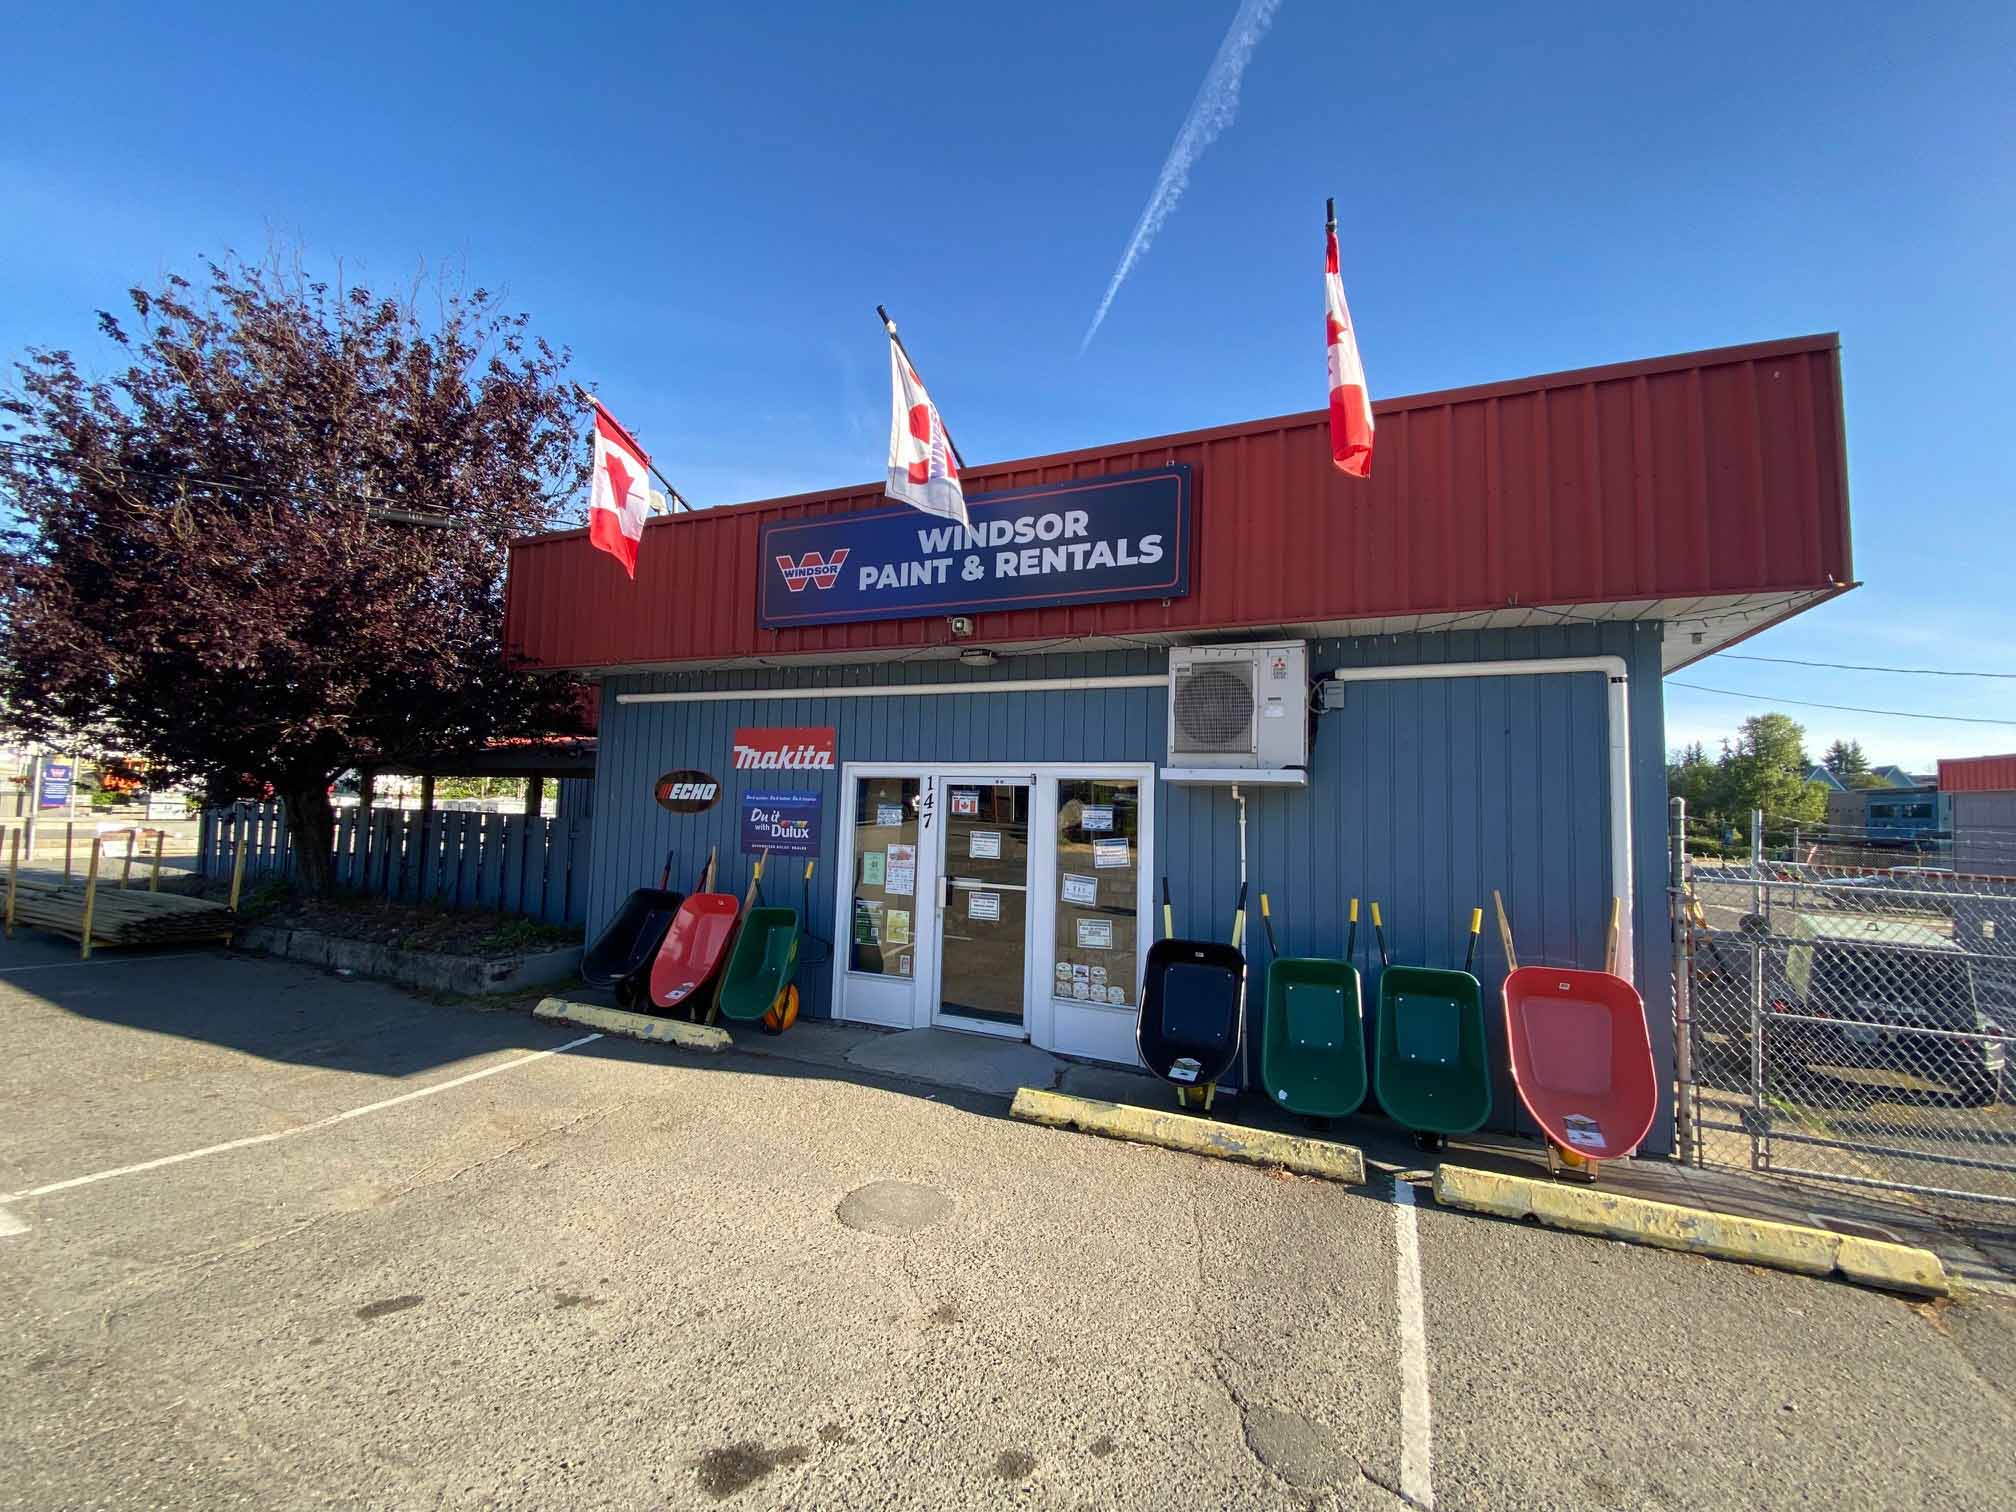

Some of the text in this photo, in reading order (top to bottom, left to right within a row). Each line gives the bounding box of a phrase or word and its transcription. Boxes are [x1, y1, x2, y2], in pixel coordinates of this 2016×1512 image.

[918, 510, 1089, 554] WINDSOR
[859, 535, 1163, 591] PAINT & RENTALS
[784, 565, 838, 578] WINDSOR
[669, 783, 717, 800] ECHO
[771, 810, 780, 822] it
[755, 823, 809, 838] with Dulux
